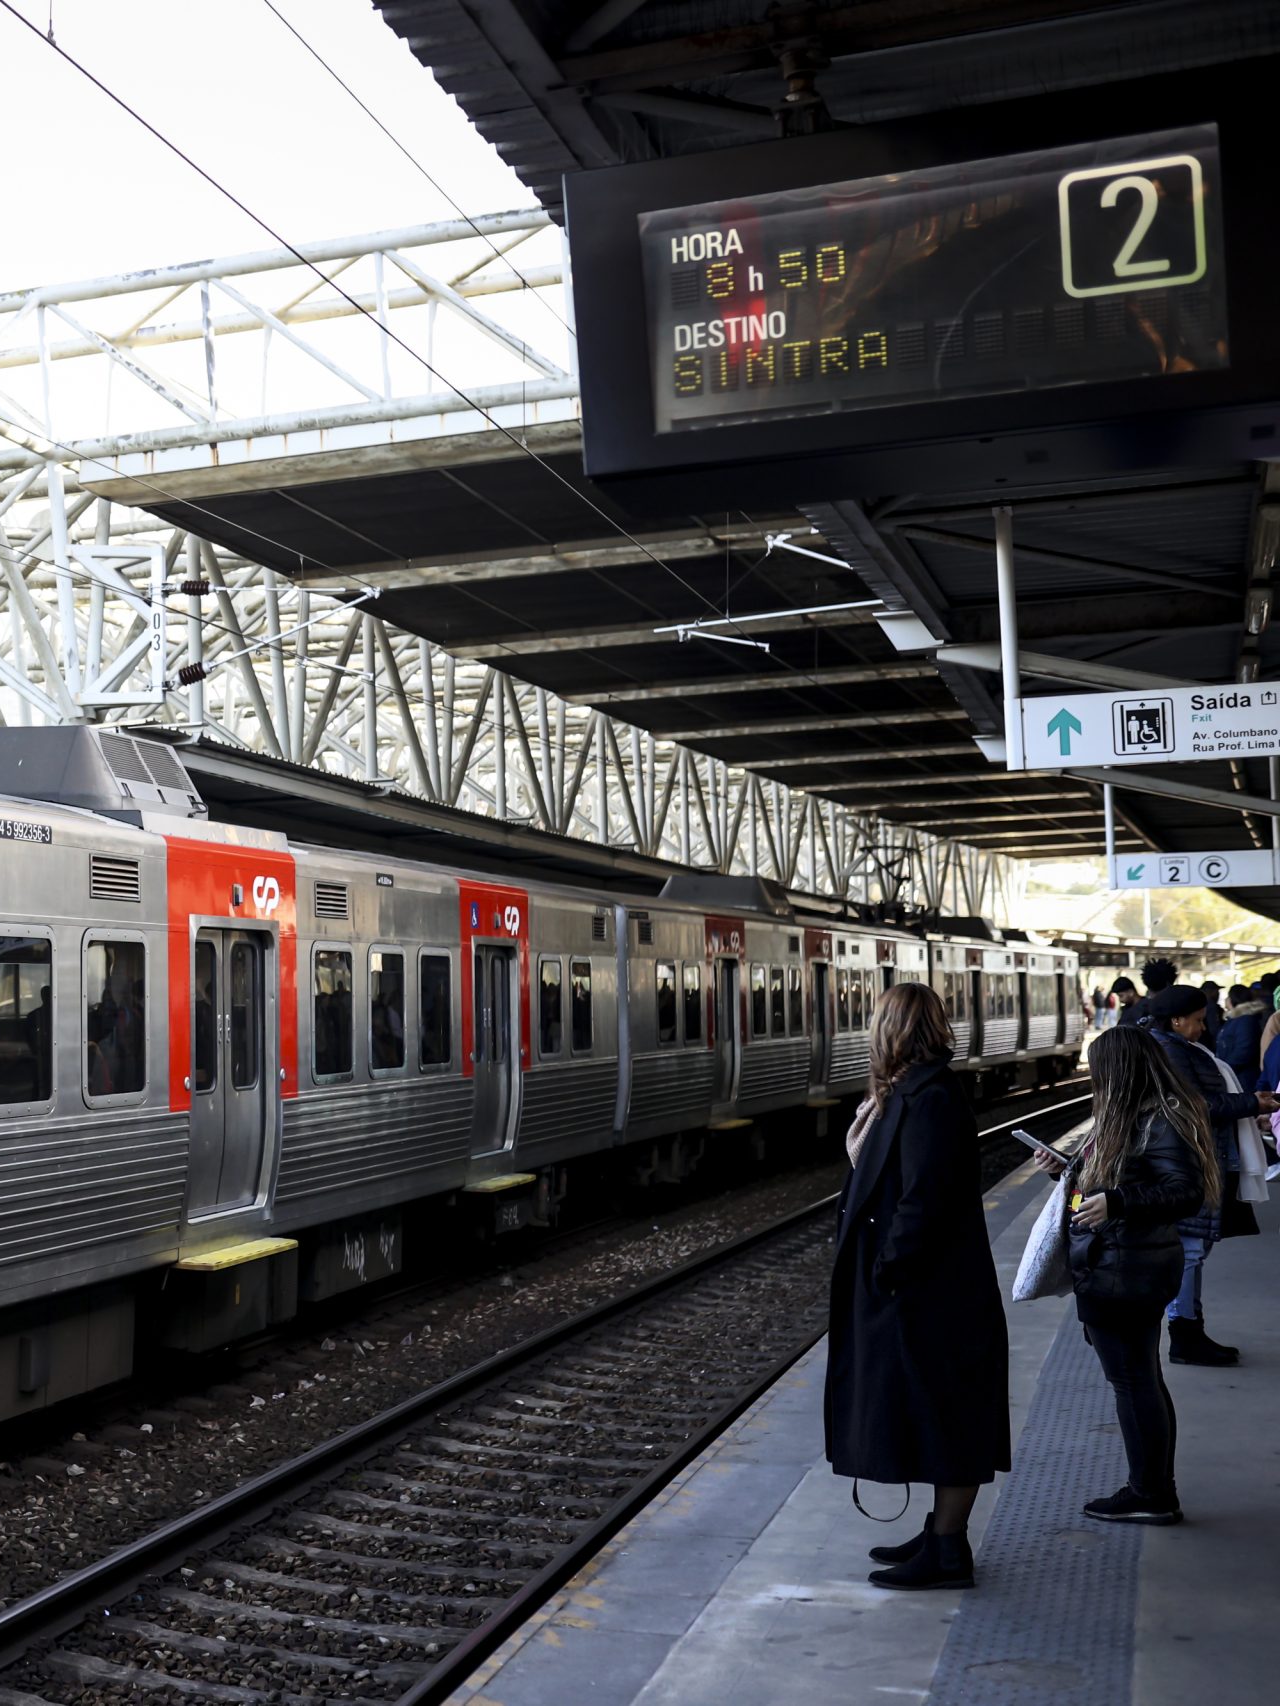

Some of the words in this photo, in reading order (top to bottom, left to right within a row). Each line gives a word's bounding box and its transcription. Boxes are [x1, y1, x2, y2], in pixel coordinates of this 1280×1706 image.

[1100, 174, 1171, 277] 2
[670, 228, 745, 264] HORA
[705, 261, 735, 300] 8
[747, 264, 764, 293] h
[778, 244, 847, 289] 50
[673, 310, 787, 352] DESTINO
[673, 331, 889, 395] SINTRA
[1191, 692, 1252, 711] Saída
[1192, 731, 1211, 741] Av.
[1213, 728, 1278, 739] Columbano
[1192, 743, 1215, 753] Rua
[1217, 741, 1245, 751] Prof.
[1247, 740, 1275, 750] Lima
[6, 820, 13, 836] 5
[13, 822, 51, 842] 992356-3
[1168, 866, 1181, 883] 2
[1206, 861, 1222, 879] C
